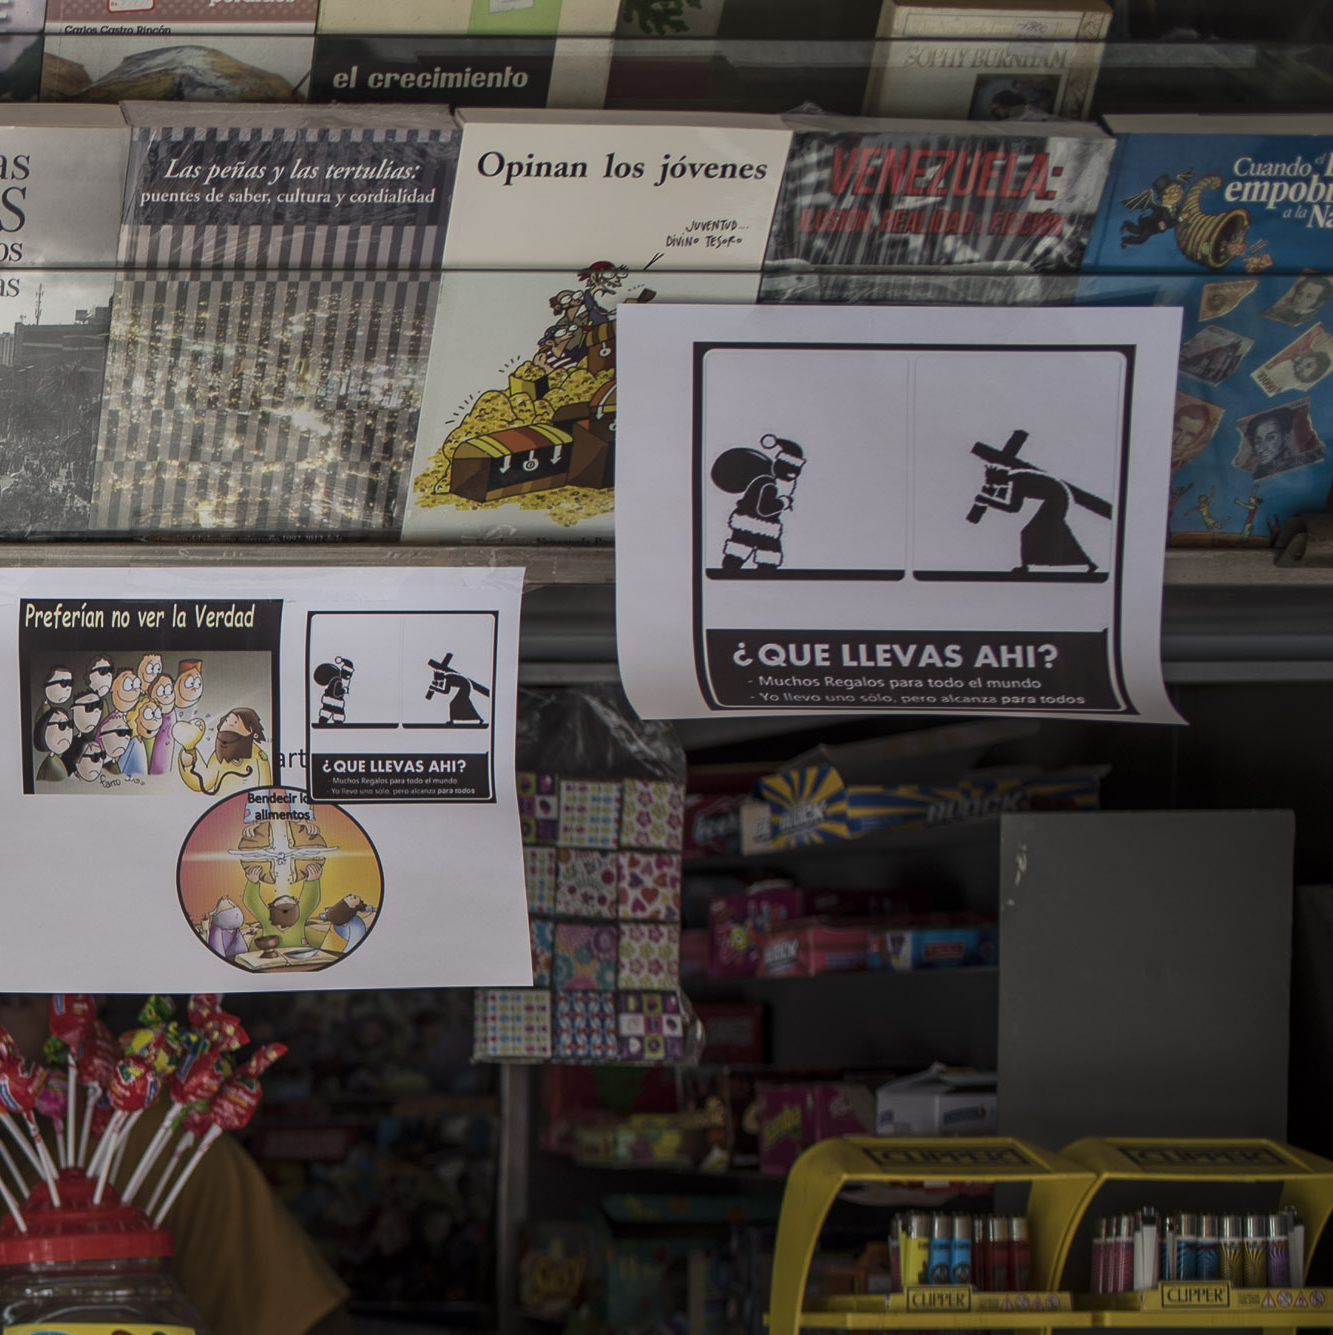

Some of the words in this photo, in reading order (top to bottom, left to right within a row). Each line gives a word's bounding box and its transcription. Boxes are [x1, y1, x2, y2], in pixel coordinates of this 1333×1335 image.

[332, 67, 357, 89] el
[367, 66, 528, 89] crecimiento
[163, 159, 199, 180] Las
[206, 157, 265, 184] peñas
[289, 159, 318, 180] las
[324, 161, 421, 182] tertulias:
[477, 152, 588, 181] Opinan
[603, 152, 645, 180] los
[658, 154, 768, 185] jóvenes
[832, 148, 1063, 199] VENEZUELA:
[140, 189, 200, 208] puentes
[206, 188, 223, 202] de
[228, 188, 272, 207] saber,
[277, 188, 330, 204] cultura
[349, 188, 435, 204] cordialidad
[26, 603, 104, 629] Preferían
[112, 610, 130, 628] no
[138, 610, 164, 628] ver
[172, 604, 186, 628] la
[195, 604, 255, 628] Verdad
[733, 642, 830, 667] ¿QUE
[842, 644, 962, 667] LLEVAS
[974, 644, 1058, 669] AHI?
[759, 676, 820, 687] Muchos
[825, 677, 884, 689] Regalos
[890, 678, 923, 689] para
[987, 678, 1041, 688] mundo
[255, 811, 309, 820] alimentos
[1166, 1287, 1225, 1303] CLIPPER
